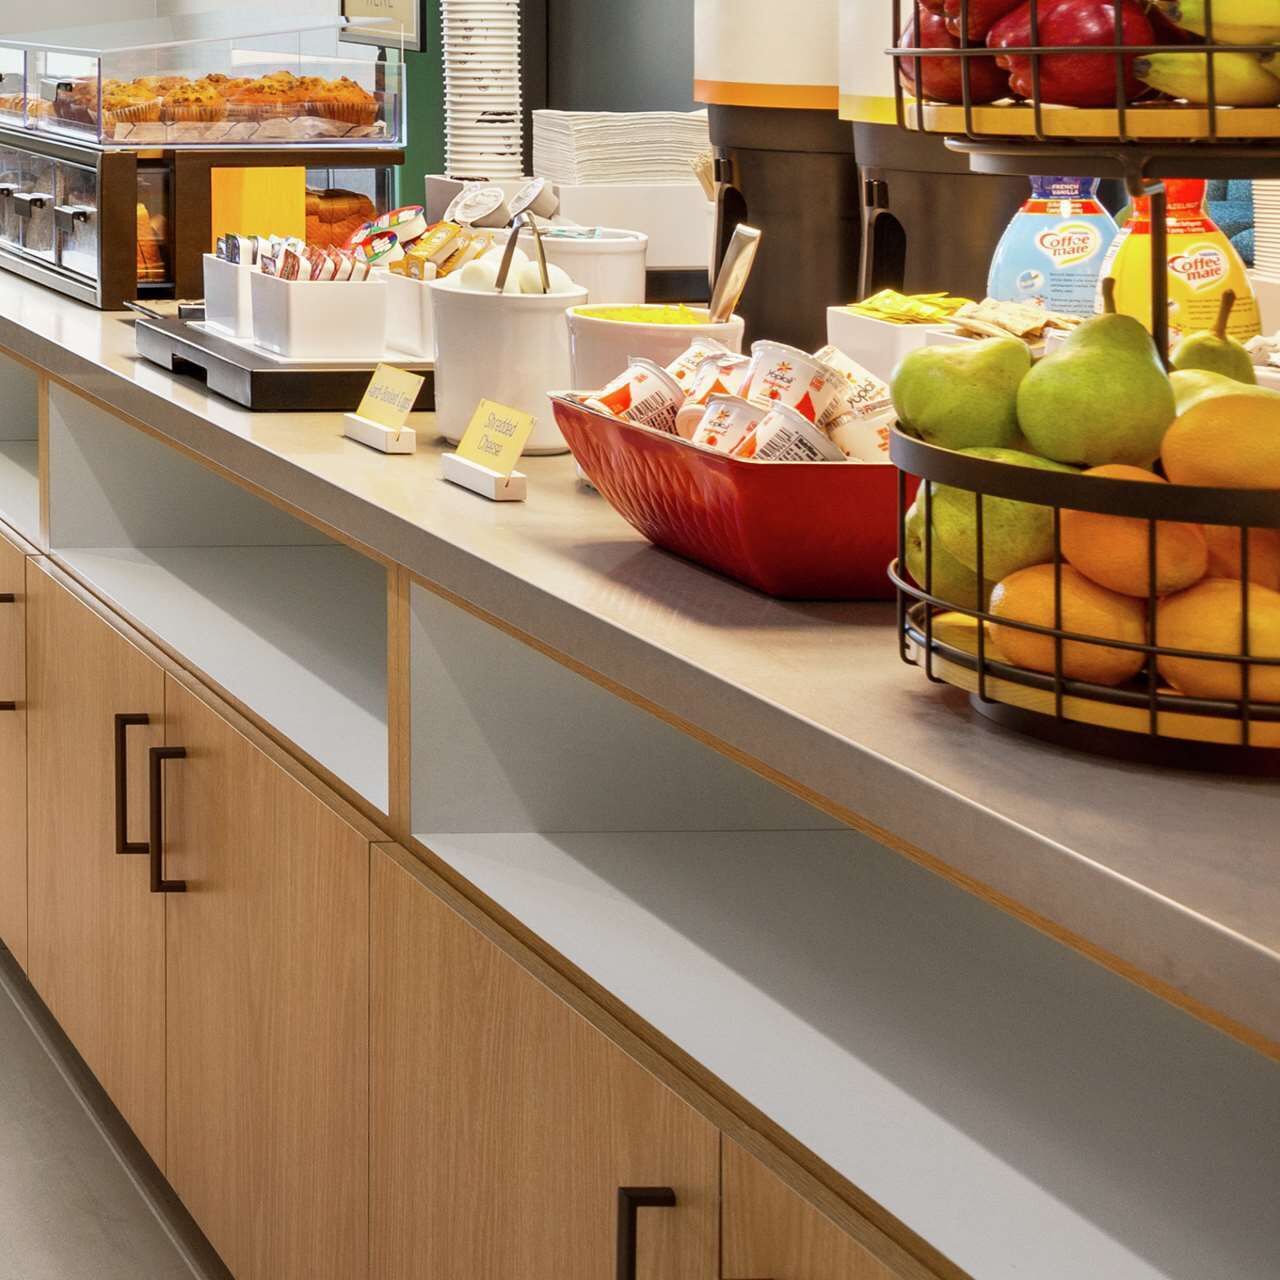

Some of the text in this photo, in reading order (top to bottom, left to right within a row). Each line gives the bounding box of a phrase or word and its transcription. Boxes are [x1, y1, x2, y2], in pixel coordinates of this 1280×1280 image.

[1039, 232, 1090, 250] Coffee
[1053, 245, 1089, 257] mate
[1168, 255, 1221, 274] Coffee
[1187, 267, 1222, 282] mate
